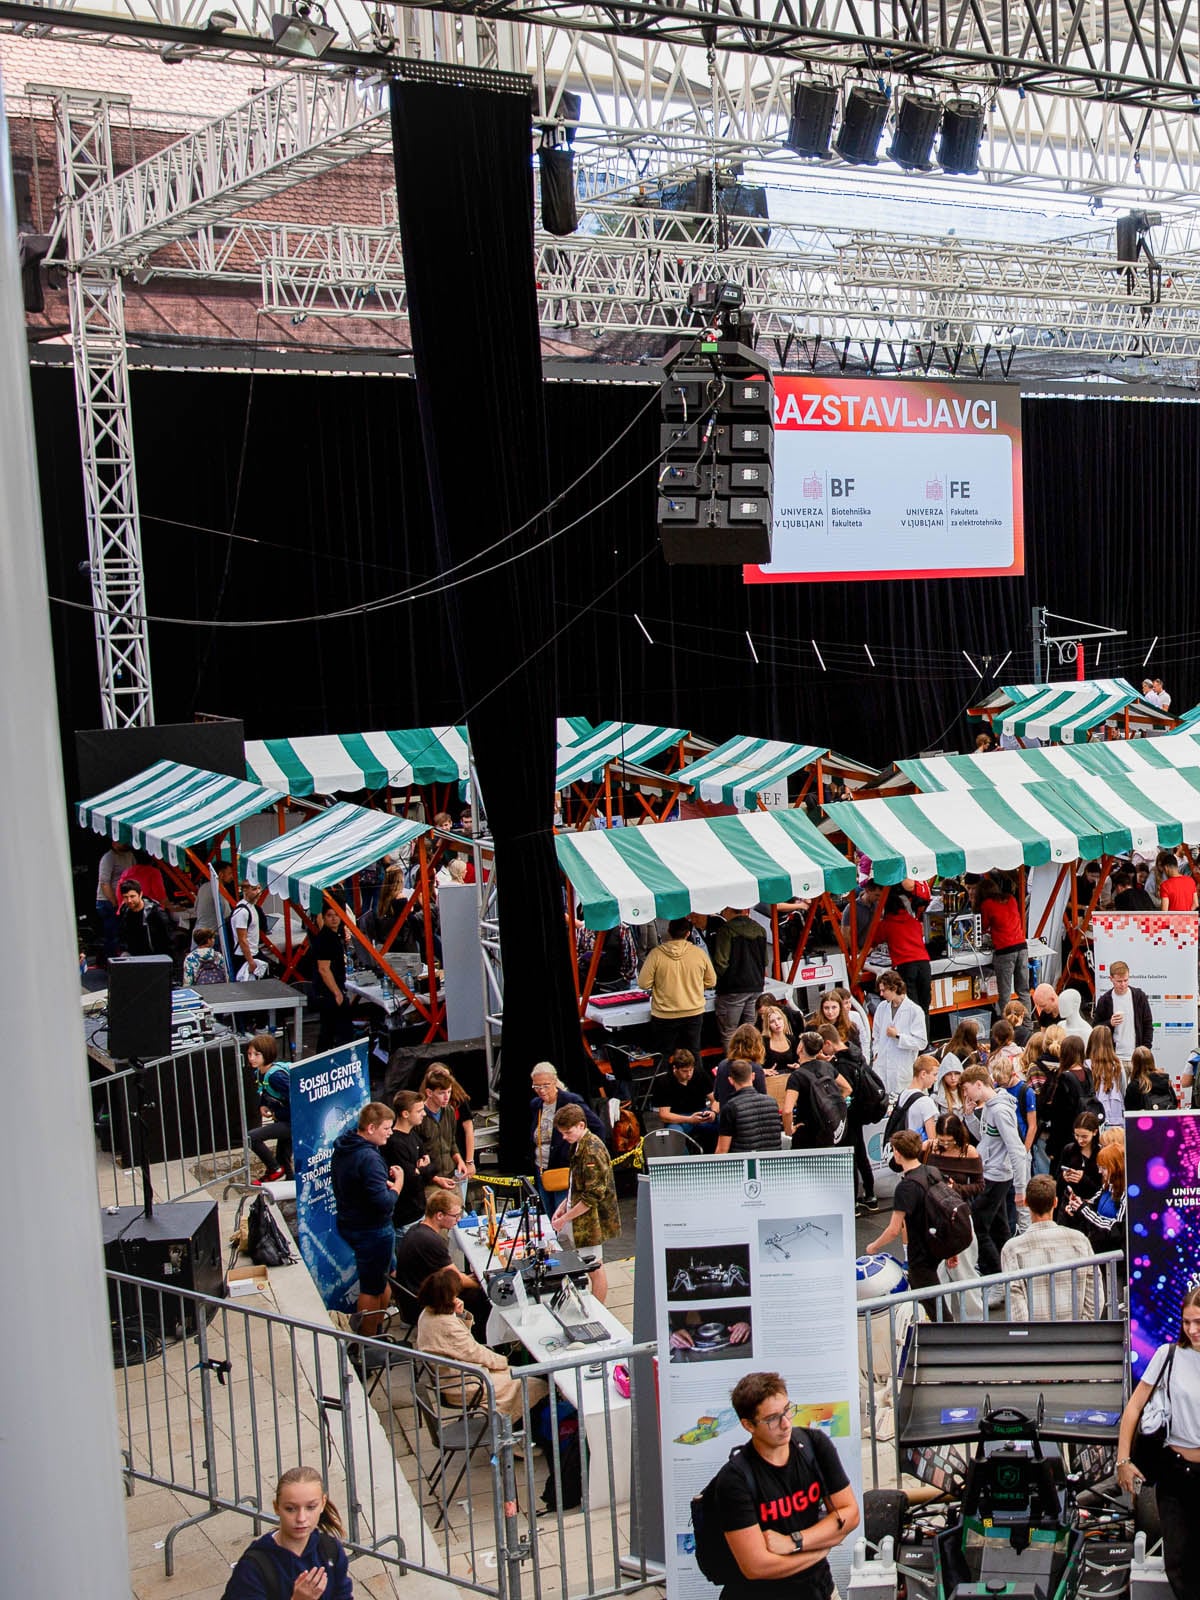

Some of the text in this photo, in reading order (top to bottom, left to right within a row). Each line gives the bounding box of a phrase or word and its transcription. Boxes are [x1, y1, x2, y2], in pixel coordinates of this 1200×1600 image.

[774, 394, 997, 429] RAZSTAVLJAVCI
[831, 478, 855, 497] BF
[950, 481, 970, 498] FE
[780, 508, 824, 516] UNIVERZA
[906, 508, 944, 516] UNIVERZA
[782, 520, 824, 529] LJUBLJANI
[832, 519, 863, 527] fakulteta
[908, 520, 944, 528] LJUBLJANI
[300, 1060, 362, 1093] ŠOLSKI CENTER
[309, 1076, 354, 1102] LJUBLJANA
[759, 1482, 821, 1521] HUGO
